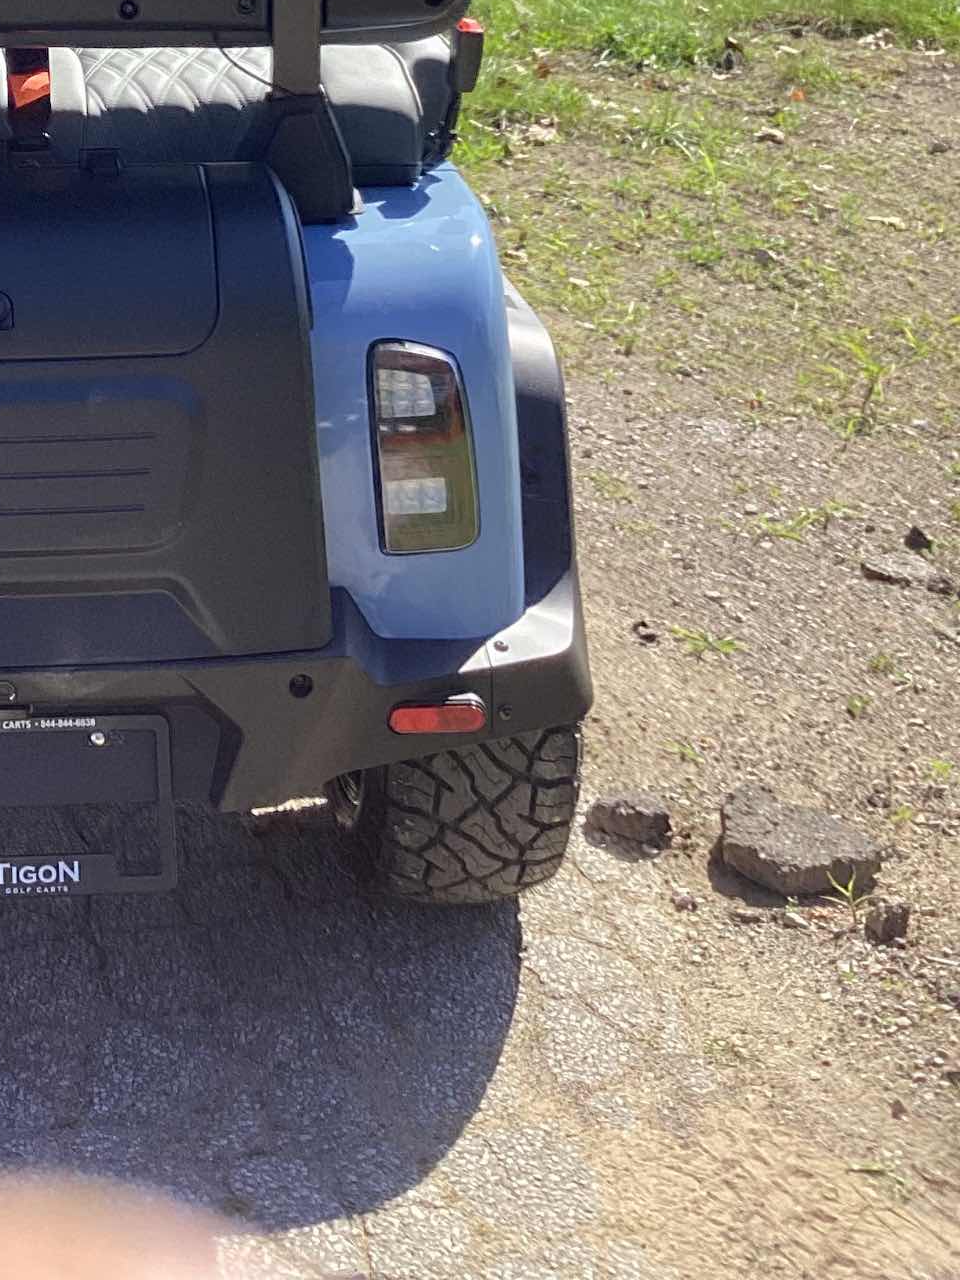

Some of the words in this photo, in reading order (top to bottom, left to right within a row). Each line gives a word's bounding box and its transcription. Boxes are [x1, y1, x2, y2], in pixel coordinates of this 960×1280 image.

[2, 720, 32, 730] CARTS
[5, 887, 32, 895] GOLF
[36, 885, 69, 894] CARTS
